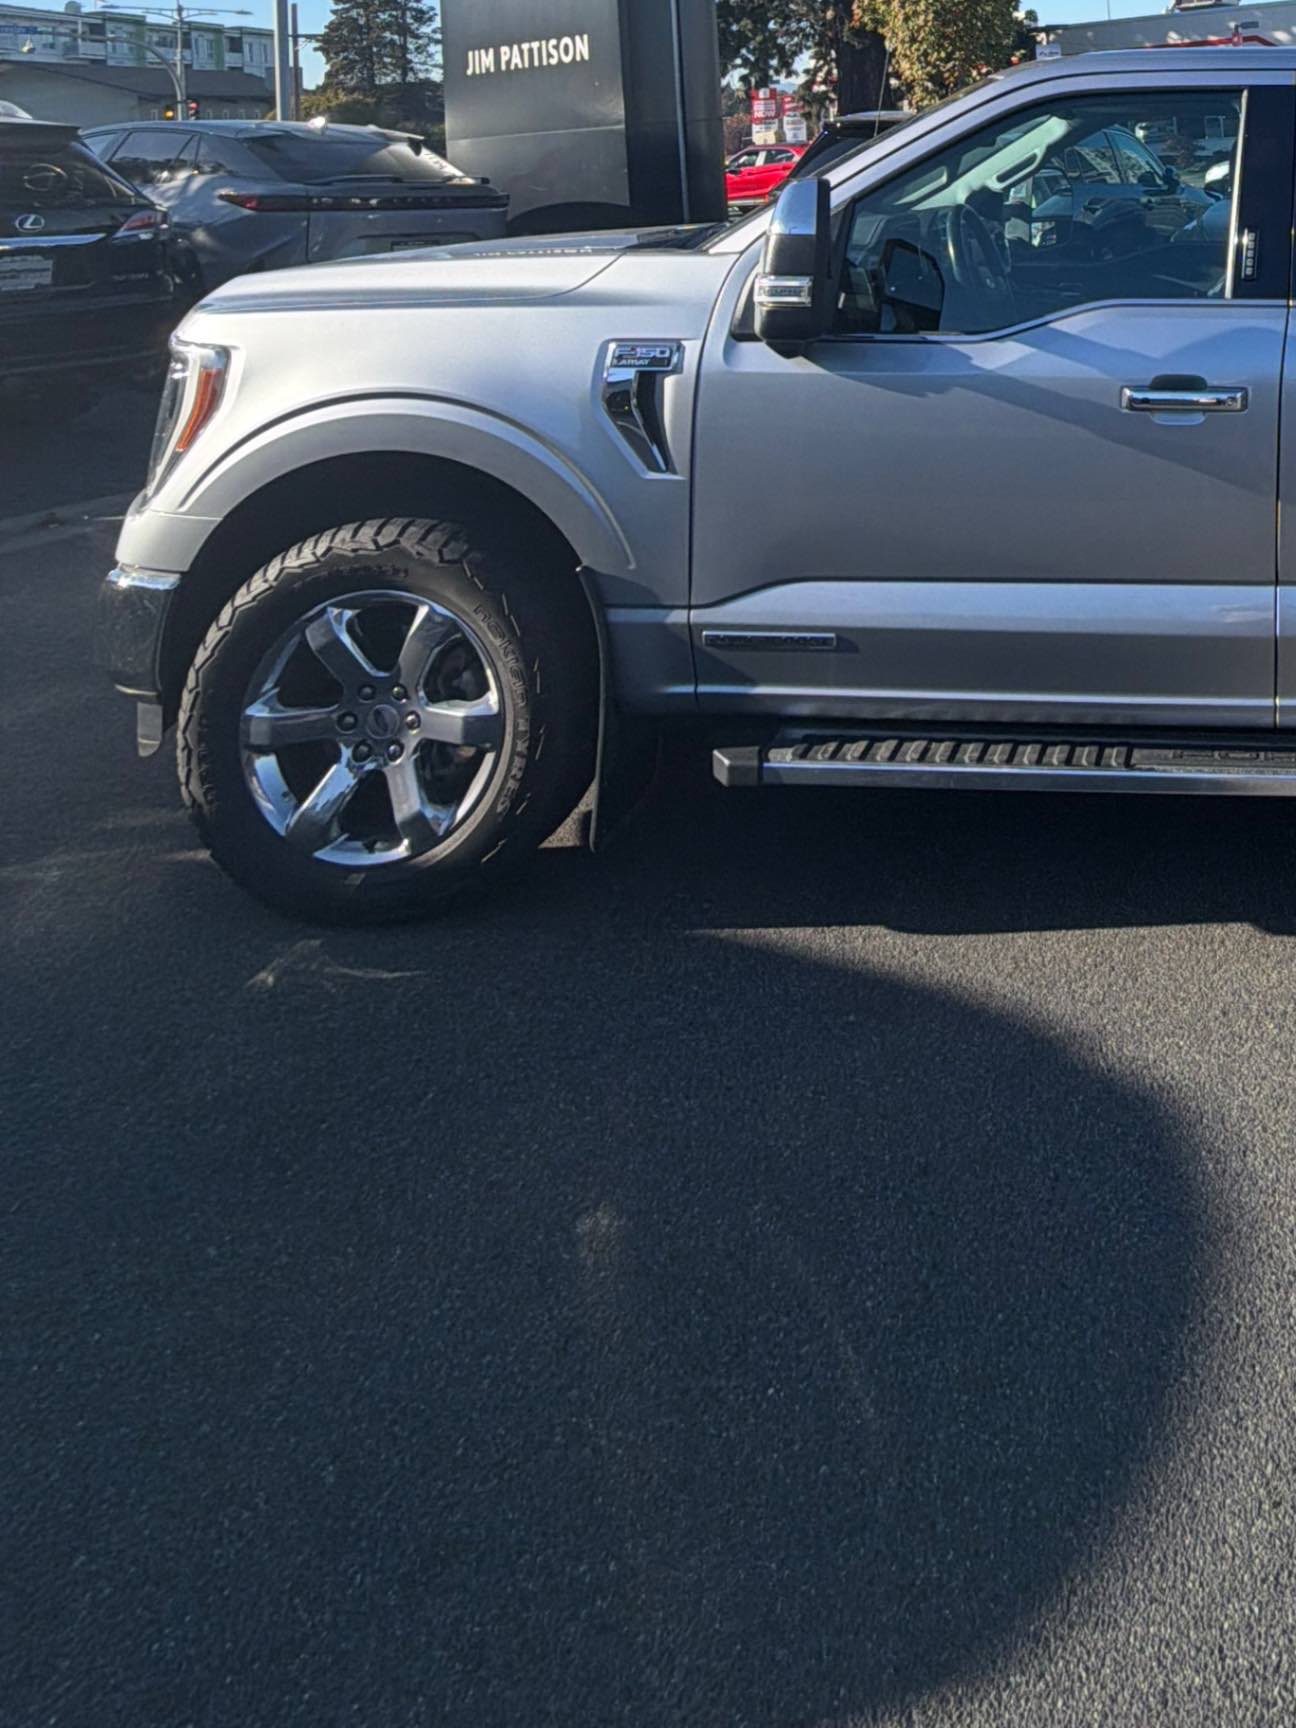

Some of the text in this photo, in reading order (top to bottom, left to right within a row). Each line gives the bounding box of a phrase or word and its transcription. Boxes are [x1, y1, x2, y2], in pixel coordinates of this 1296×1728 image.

[466, 34, 589, 76] JIM PATTISON
[615, 347, 670, 358] F-150
[496, 719, 530, 816] TYRES
